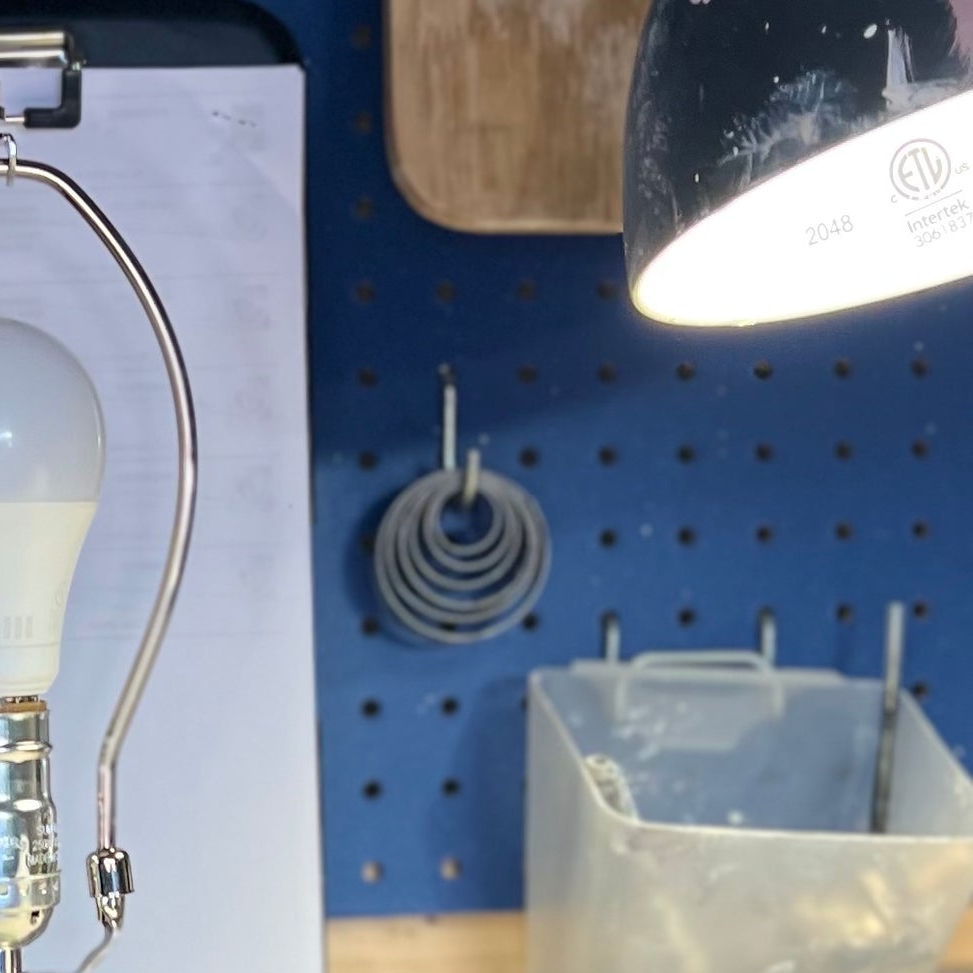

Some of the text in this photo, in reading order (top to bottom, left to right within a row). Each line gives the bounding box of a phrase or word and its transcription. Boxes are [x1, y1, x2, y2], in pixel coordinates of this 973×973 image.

[806, 215, 854, 246] 2048
[907, 199, 970, 233] Intertek
[913, 212, 973, 248] 3061837
